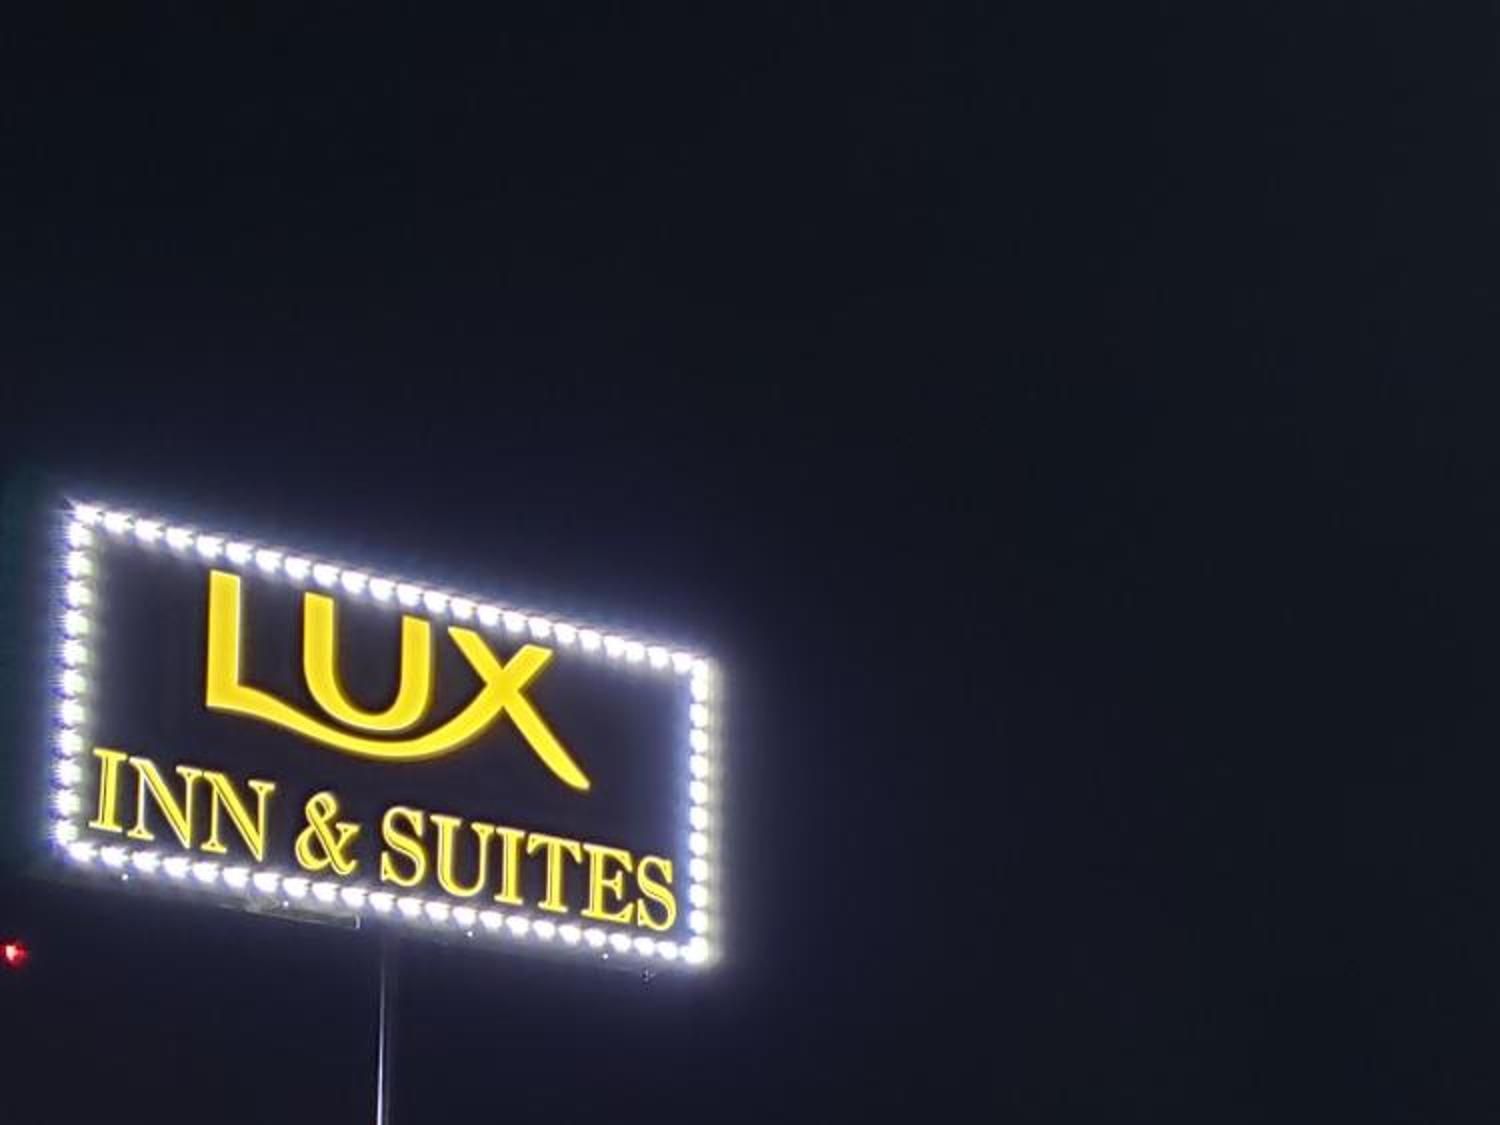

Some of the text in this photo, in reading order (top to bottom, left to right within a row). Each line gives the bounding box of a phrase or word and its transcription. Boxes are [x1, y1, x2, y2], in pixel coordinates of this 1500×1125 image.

[206, 569, 591, 791] LUX
[89, 747, 678, 931] INN & SUITES
